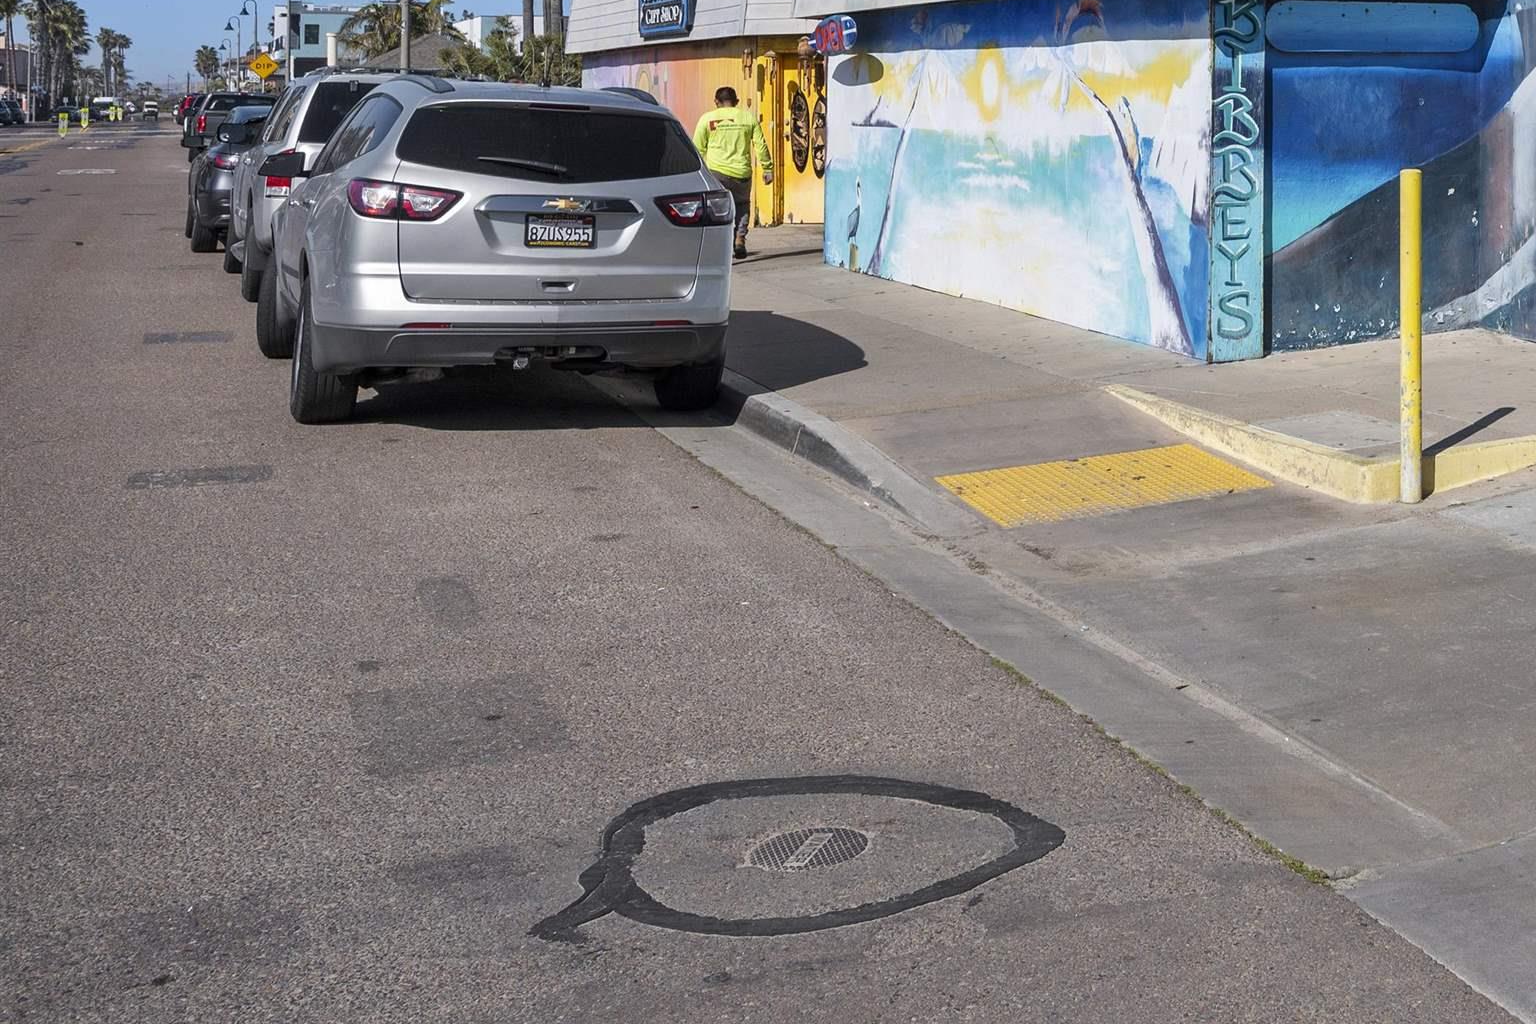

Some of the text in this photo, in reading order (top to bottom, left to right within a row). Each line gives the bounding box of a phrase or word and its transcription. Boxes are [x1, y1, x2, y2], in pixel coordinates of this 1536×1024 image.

[645, 5, 680, 25] GIFT SHOP
[815, 20, 844, 53] OPEN
[529, 226, 590, 242] 8ZUS955
